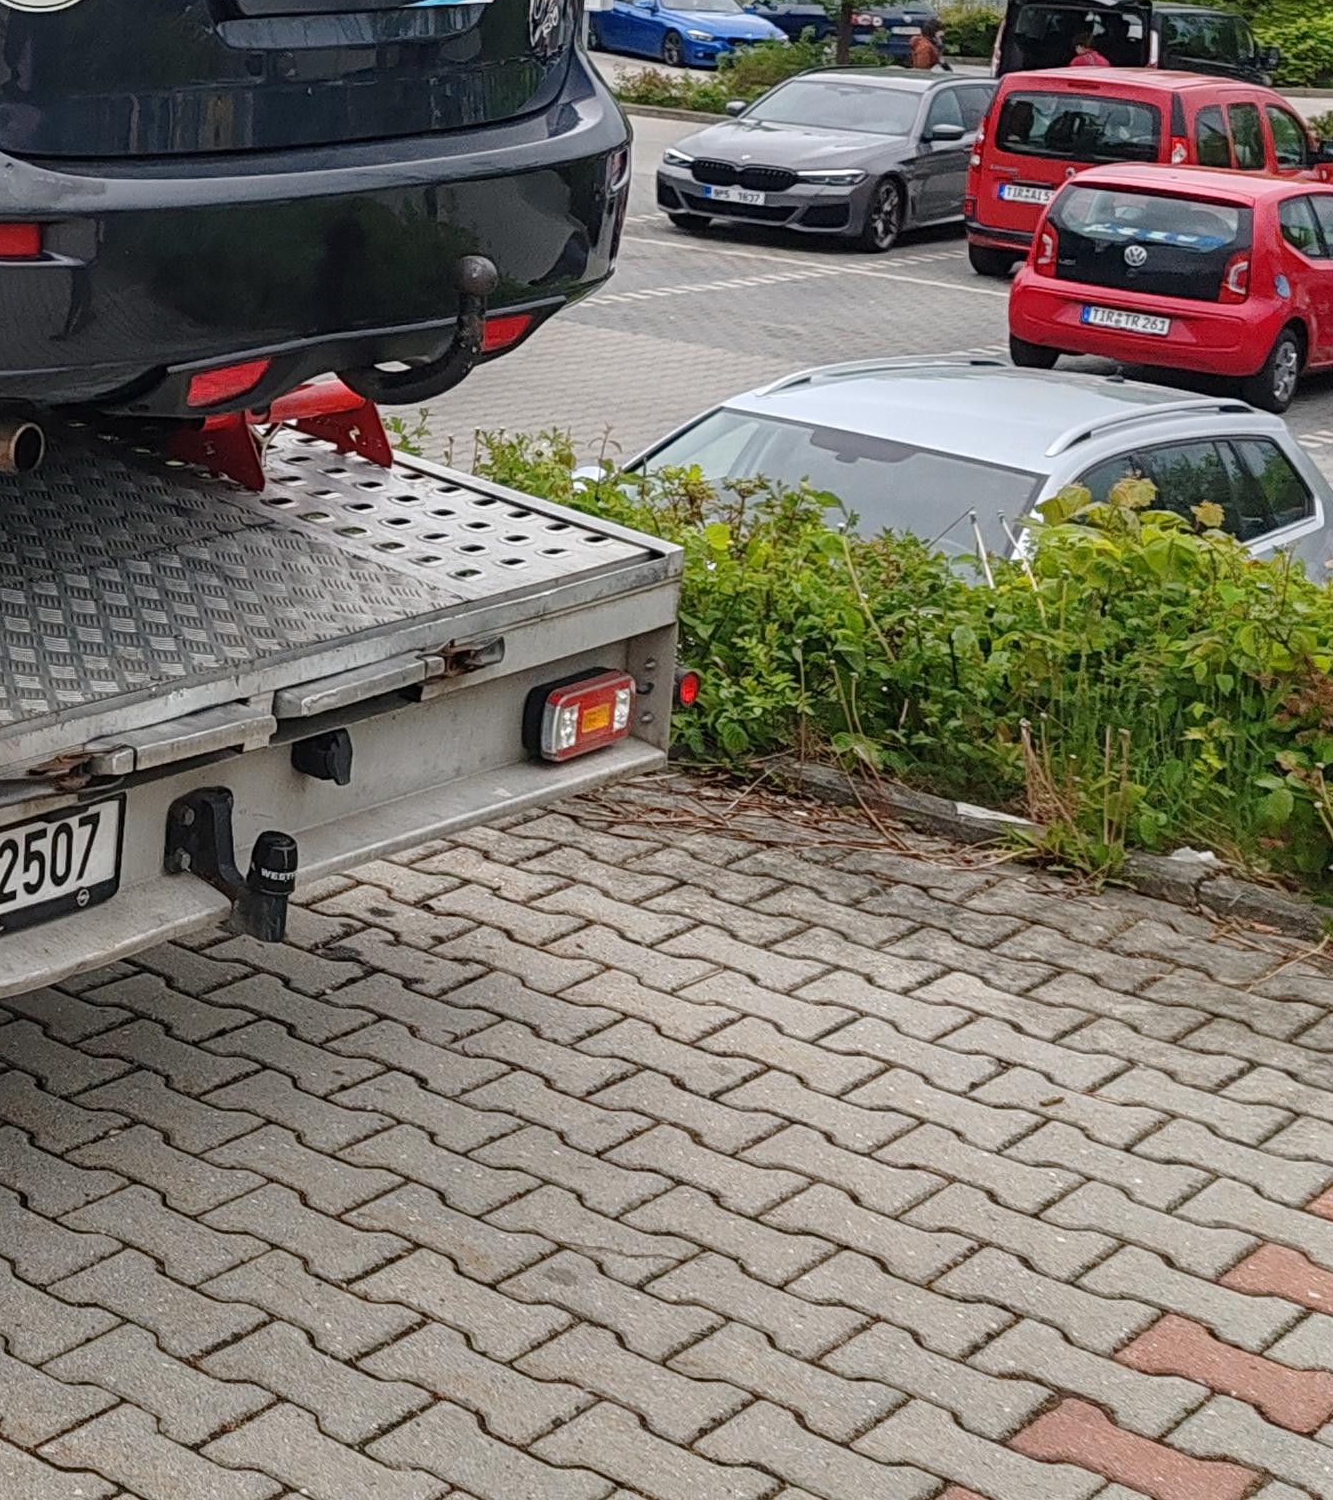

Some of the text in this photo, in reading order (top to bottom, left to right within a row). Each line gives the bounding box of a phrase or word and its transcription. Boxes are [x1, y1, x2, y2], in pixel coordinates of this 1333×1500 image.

[1093, 308, 1166, 332] TIR TR 261
